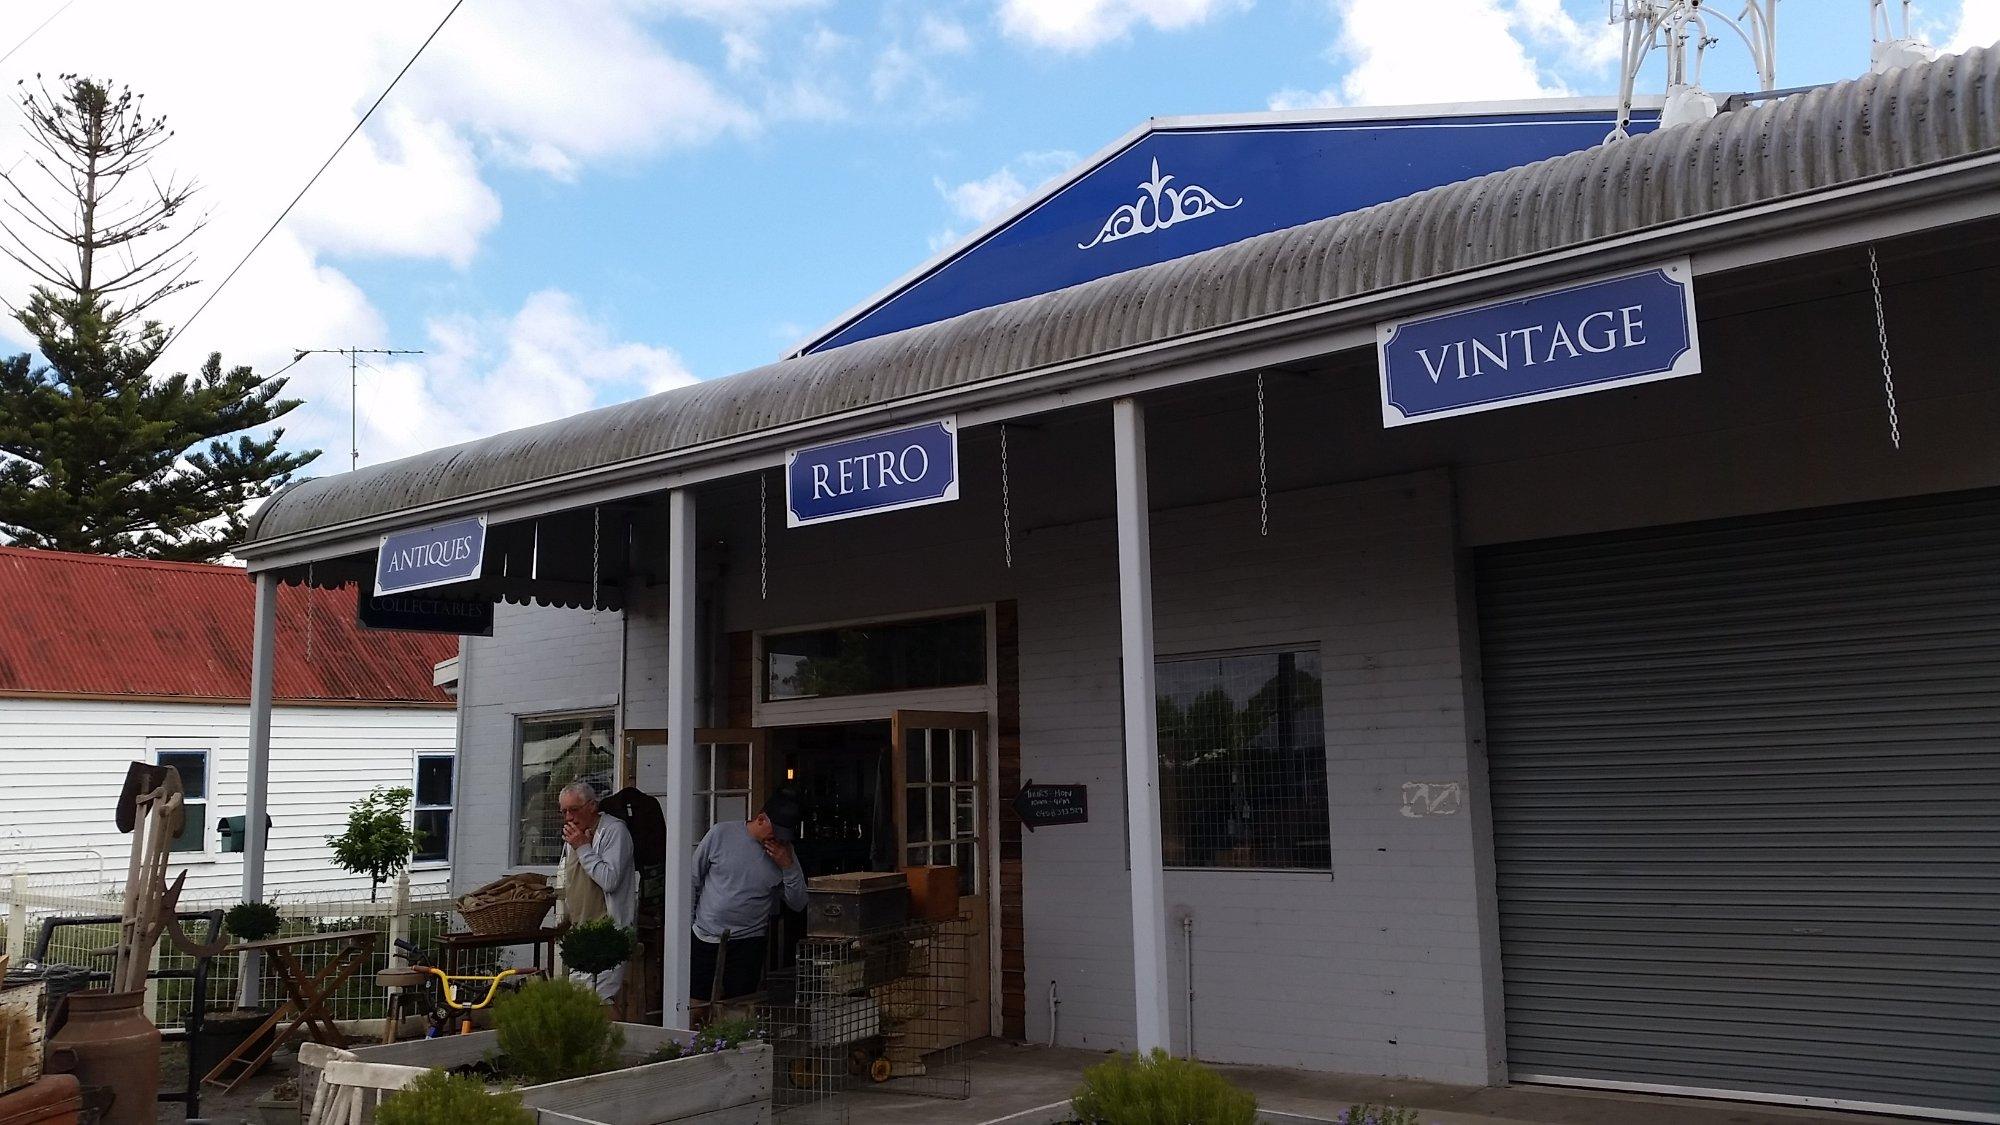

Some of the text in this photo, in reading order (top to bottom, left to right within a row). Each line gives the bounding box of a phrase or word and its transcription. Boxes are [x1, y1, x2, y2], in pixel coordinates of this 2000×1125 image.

[1415, 304, 1647, 384] VINTAGE
[811, 444, 929, 500] RETRO
[387, 535, 472, 573] ANTIQUES
[369, 597, 483, 617] COLLECTABLES
